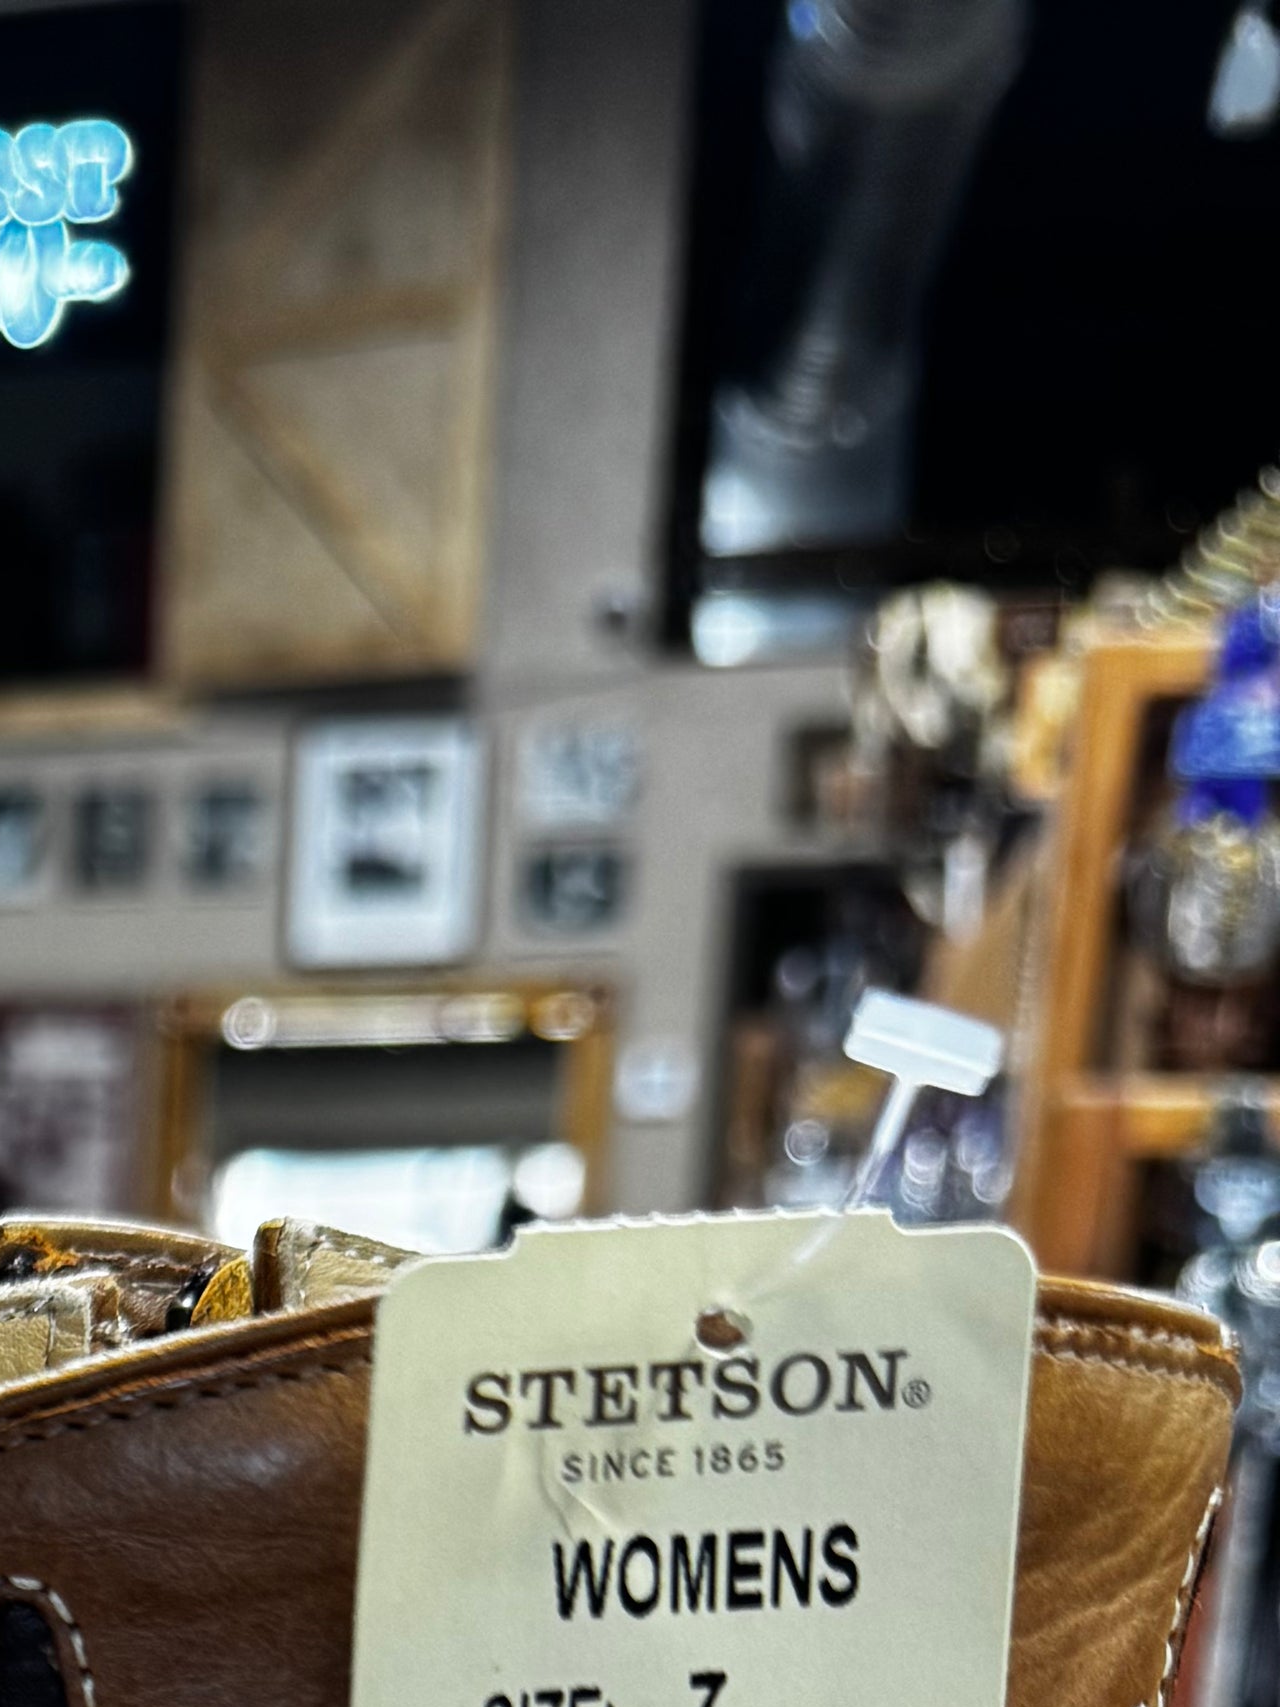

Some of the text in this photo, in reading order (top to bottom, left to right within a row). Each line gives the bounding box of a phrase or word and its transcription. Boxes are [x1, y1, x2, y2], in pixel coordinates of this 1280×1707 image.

[561, 1440, 787, 1485] SINCE 1865
[551, 1521, 861, 1622] WOMENS
